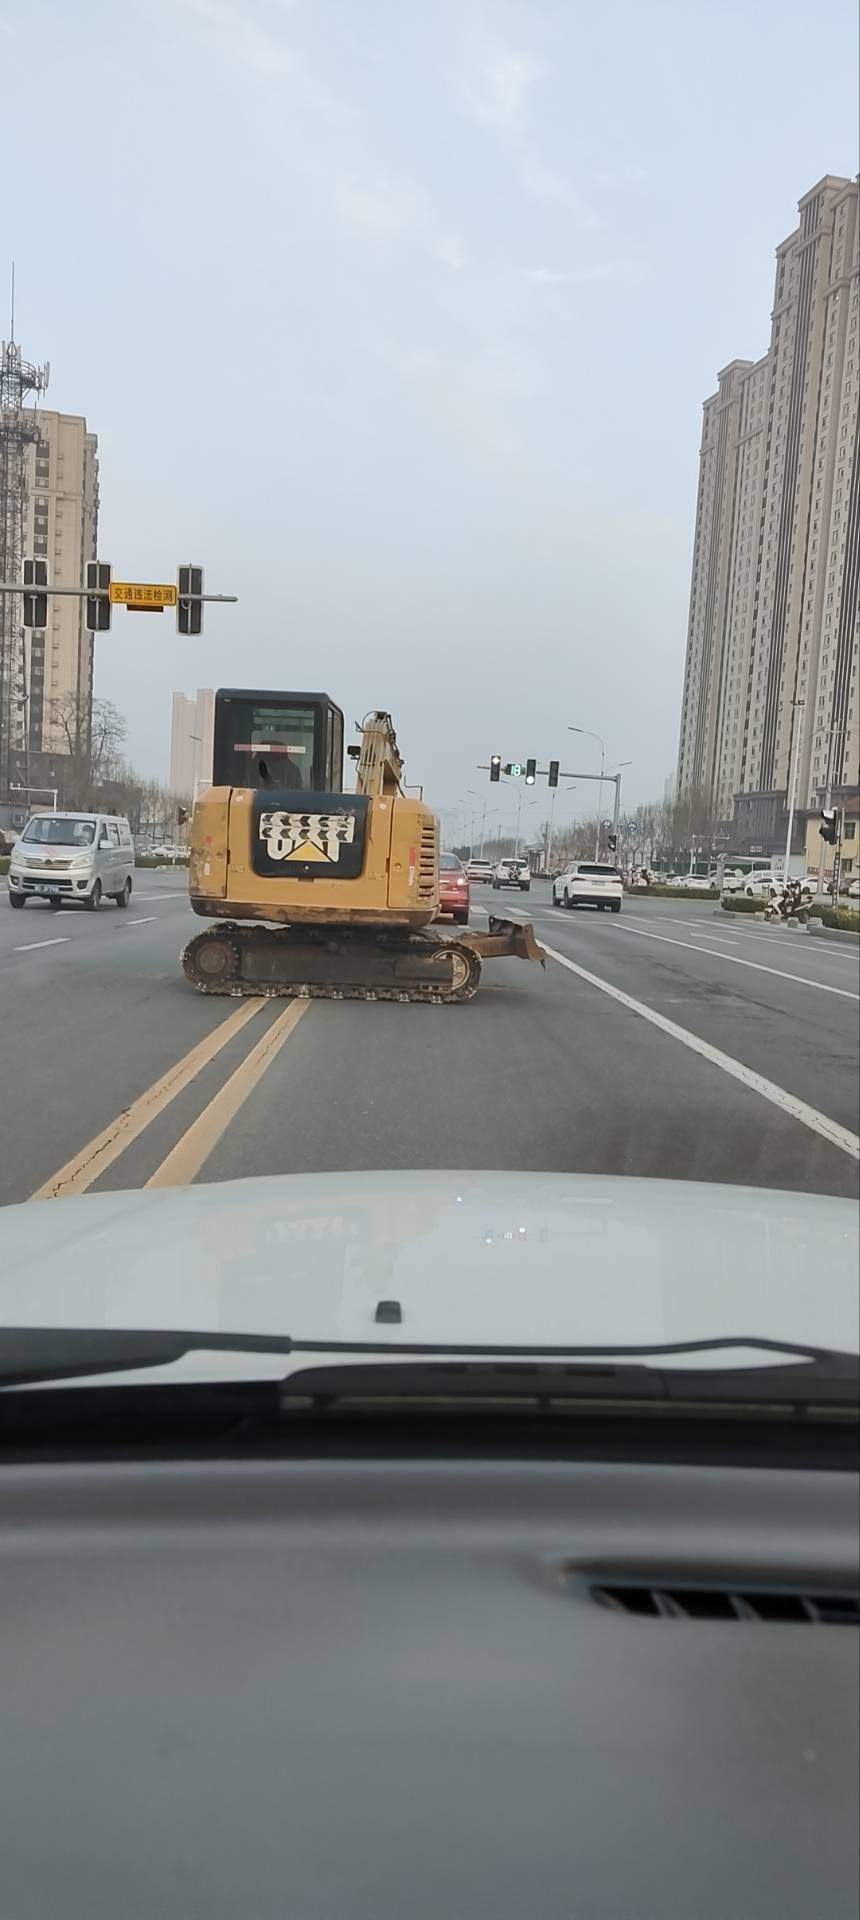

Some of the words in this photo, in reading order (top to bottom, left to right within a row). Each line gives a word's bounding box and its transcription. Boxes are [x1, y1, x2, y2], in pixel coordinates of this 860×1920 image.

[114, 587, 173, 601] 交通违法检测
